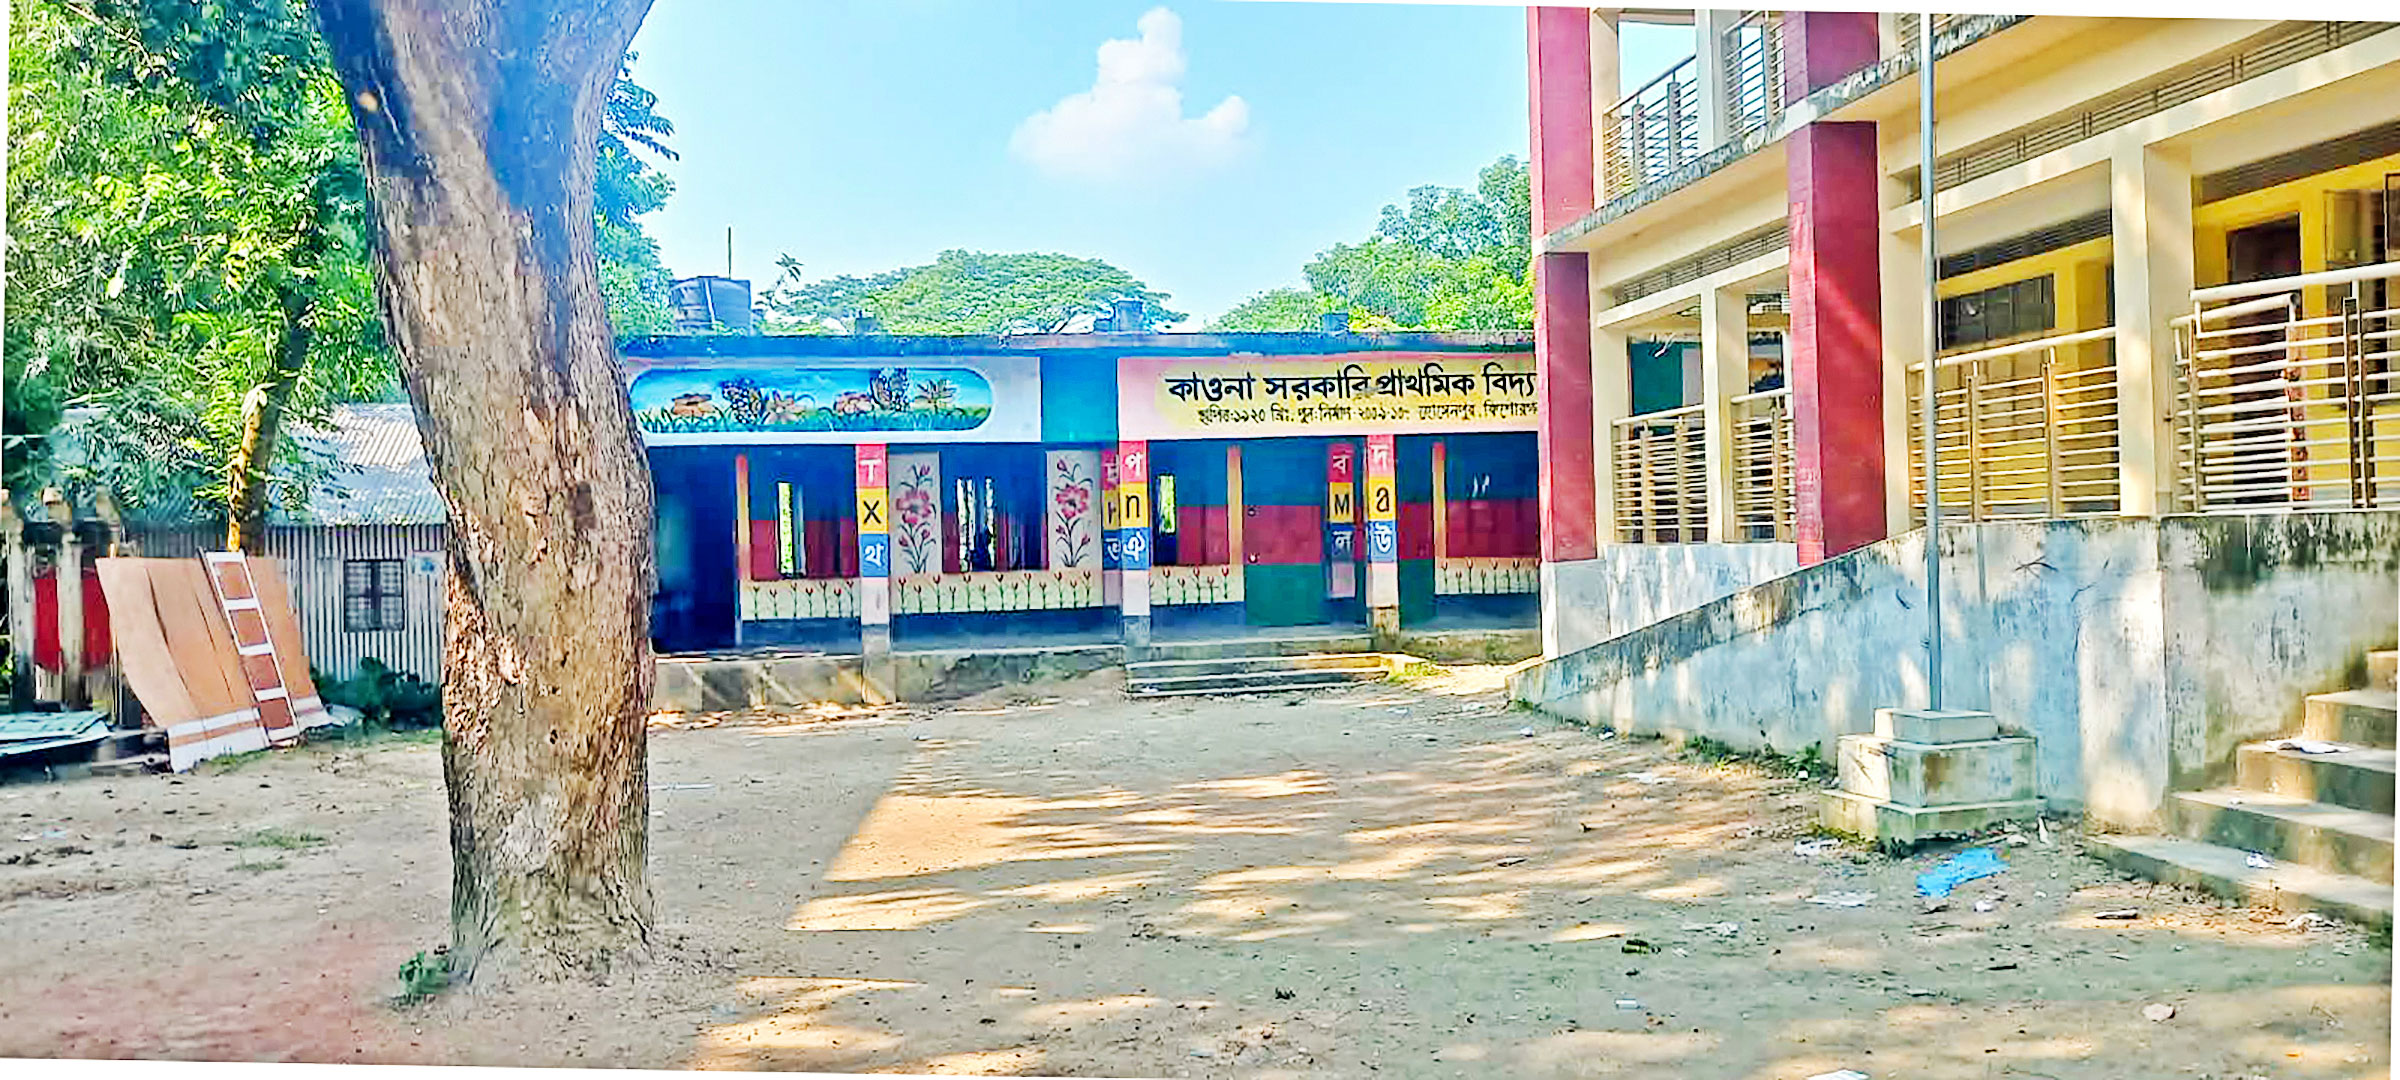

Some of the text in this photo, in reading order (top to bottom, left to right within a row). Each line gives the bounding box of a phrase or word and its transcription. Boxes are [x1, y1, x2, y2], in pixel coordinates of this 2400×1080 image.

[1165, 371, 1256, 402] কাওনা
[1375, 362, 1475, 397] প্রাথমিক
[1376, 487, 1390, 513] a
